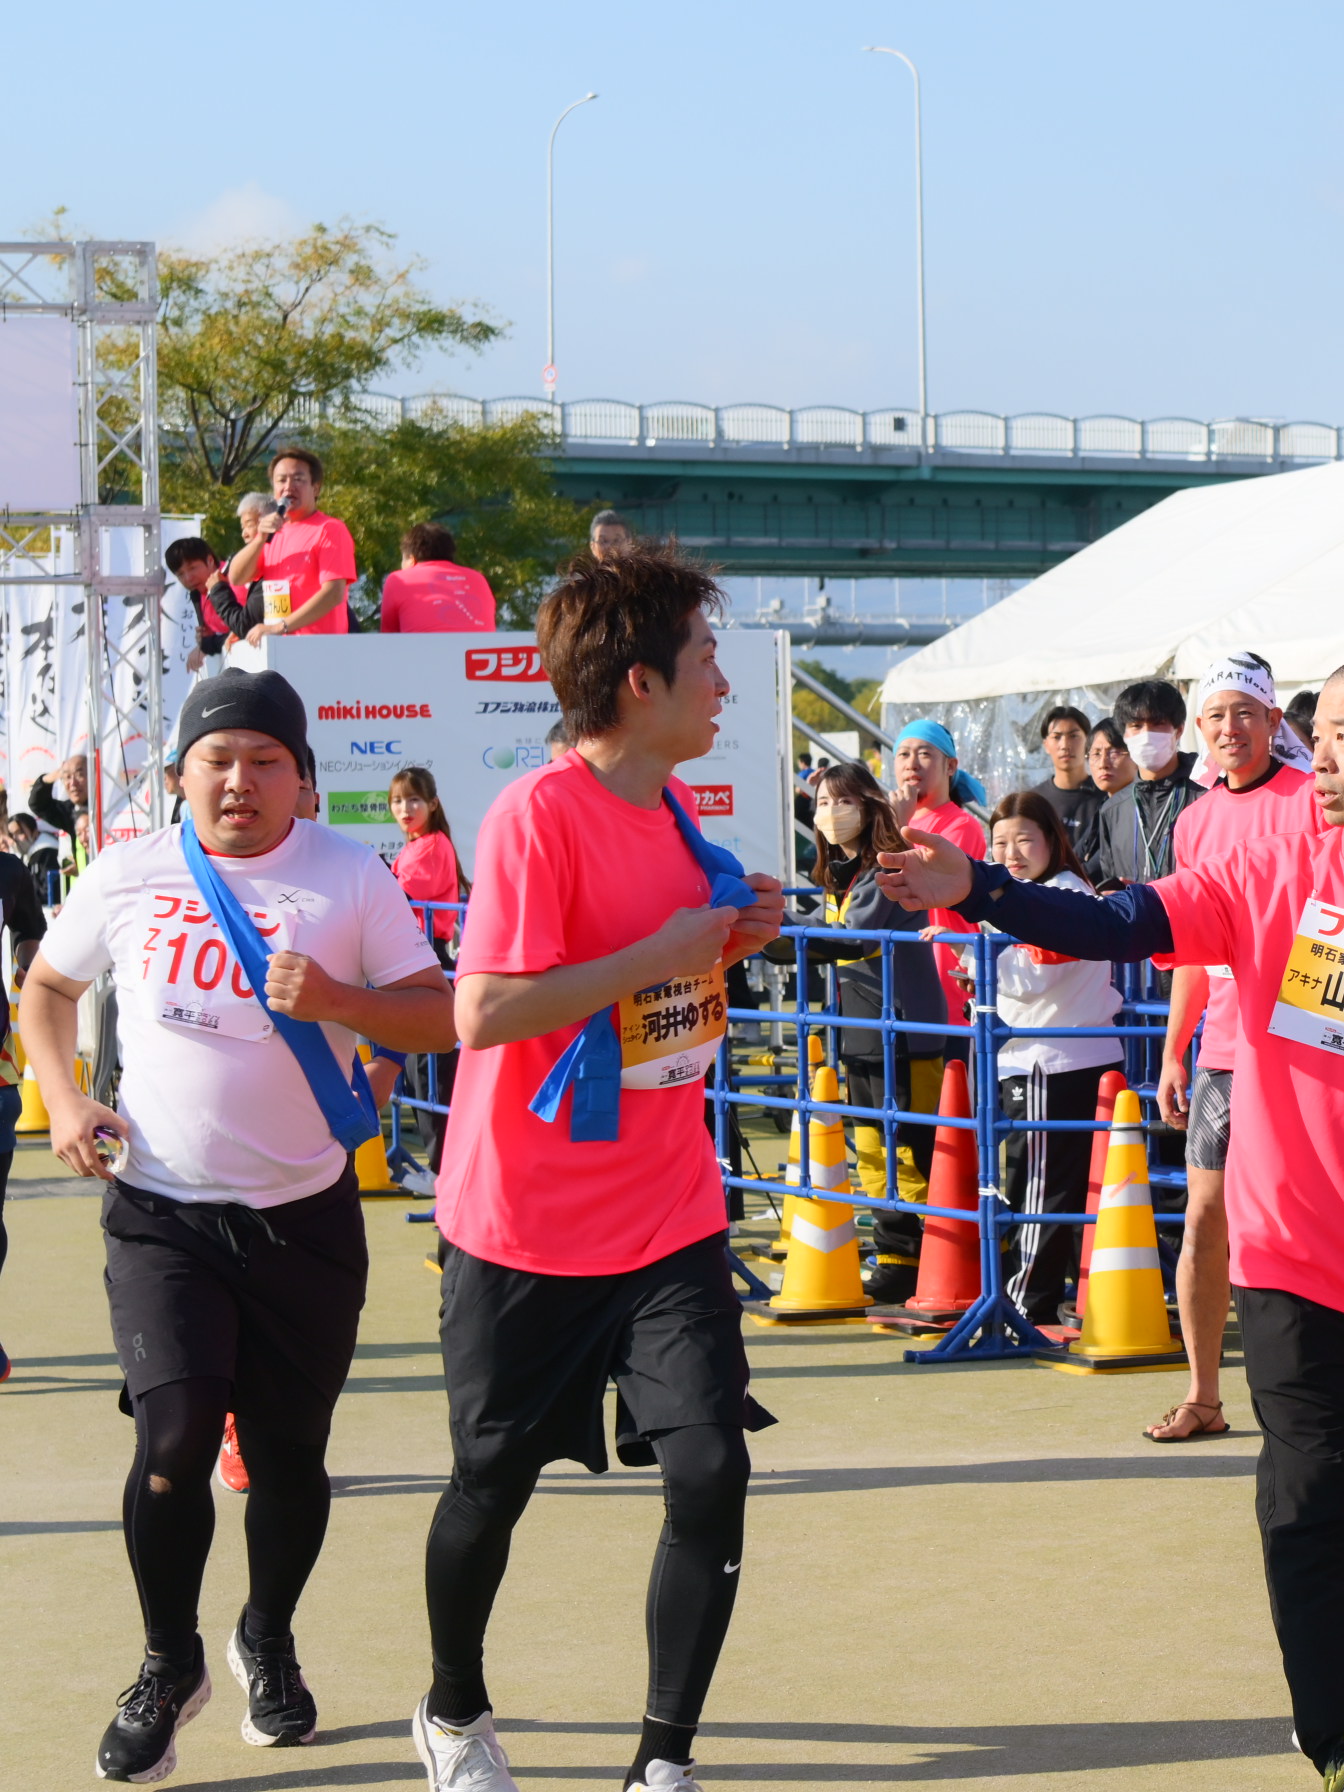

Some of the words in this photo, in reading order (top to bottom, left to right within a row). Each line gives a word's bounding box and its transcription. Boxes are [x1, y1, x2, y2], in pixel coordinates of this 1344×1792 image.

[364, 704, 432, 719] HOUSE
[350, 740, 402, 755] NEC
[154, 894, 281, 938] フジン
[1287, 968, 1323, 990] アキナ
[642, 993, 724, 1045] 河井ゆずる
